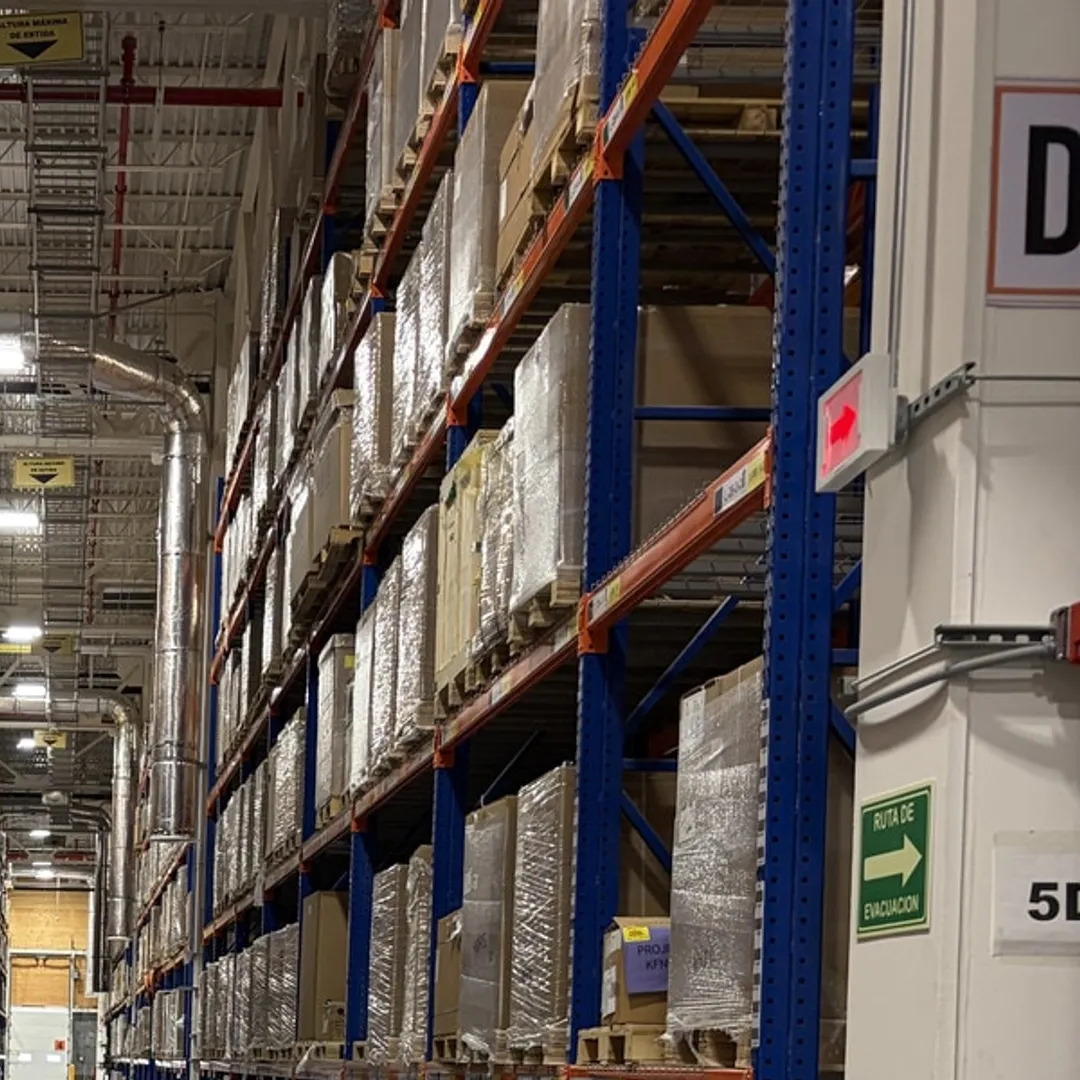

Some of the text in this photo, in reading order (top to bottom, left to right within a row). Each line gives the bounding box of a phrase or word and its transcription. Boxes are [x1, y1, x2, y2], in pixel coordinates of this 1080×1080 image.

[1025, 125, 1080, 255] D
[873, 802, 915, 831] RUTA DE
